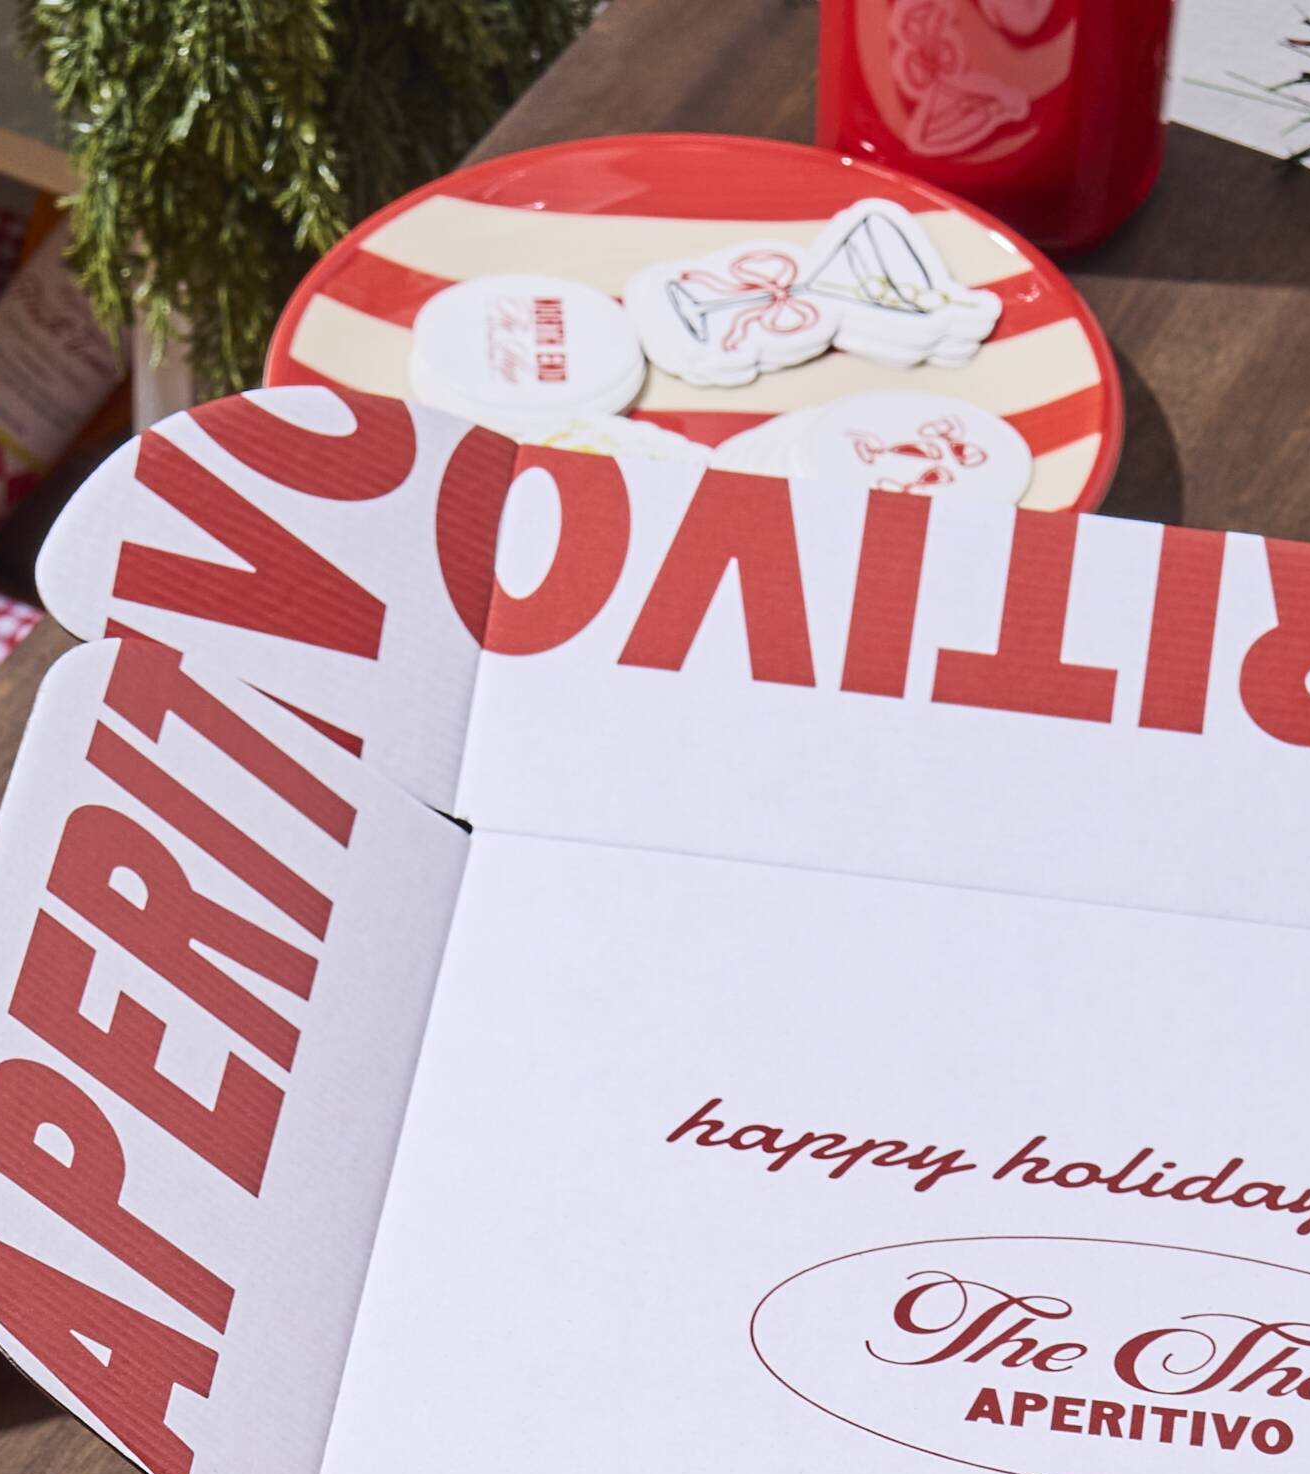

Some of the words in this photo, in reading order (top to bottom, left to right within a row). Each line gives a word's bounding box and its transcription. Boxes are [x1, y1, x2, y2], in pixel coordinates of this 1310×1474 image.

[666, 1097, 978, 1194] happy
[864, 1269, 1092, 1377] The
[963, 1386, 1295, 1457] APERITIVO
